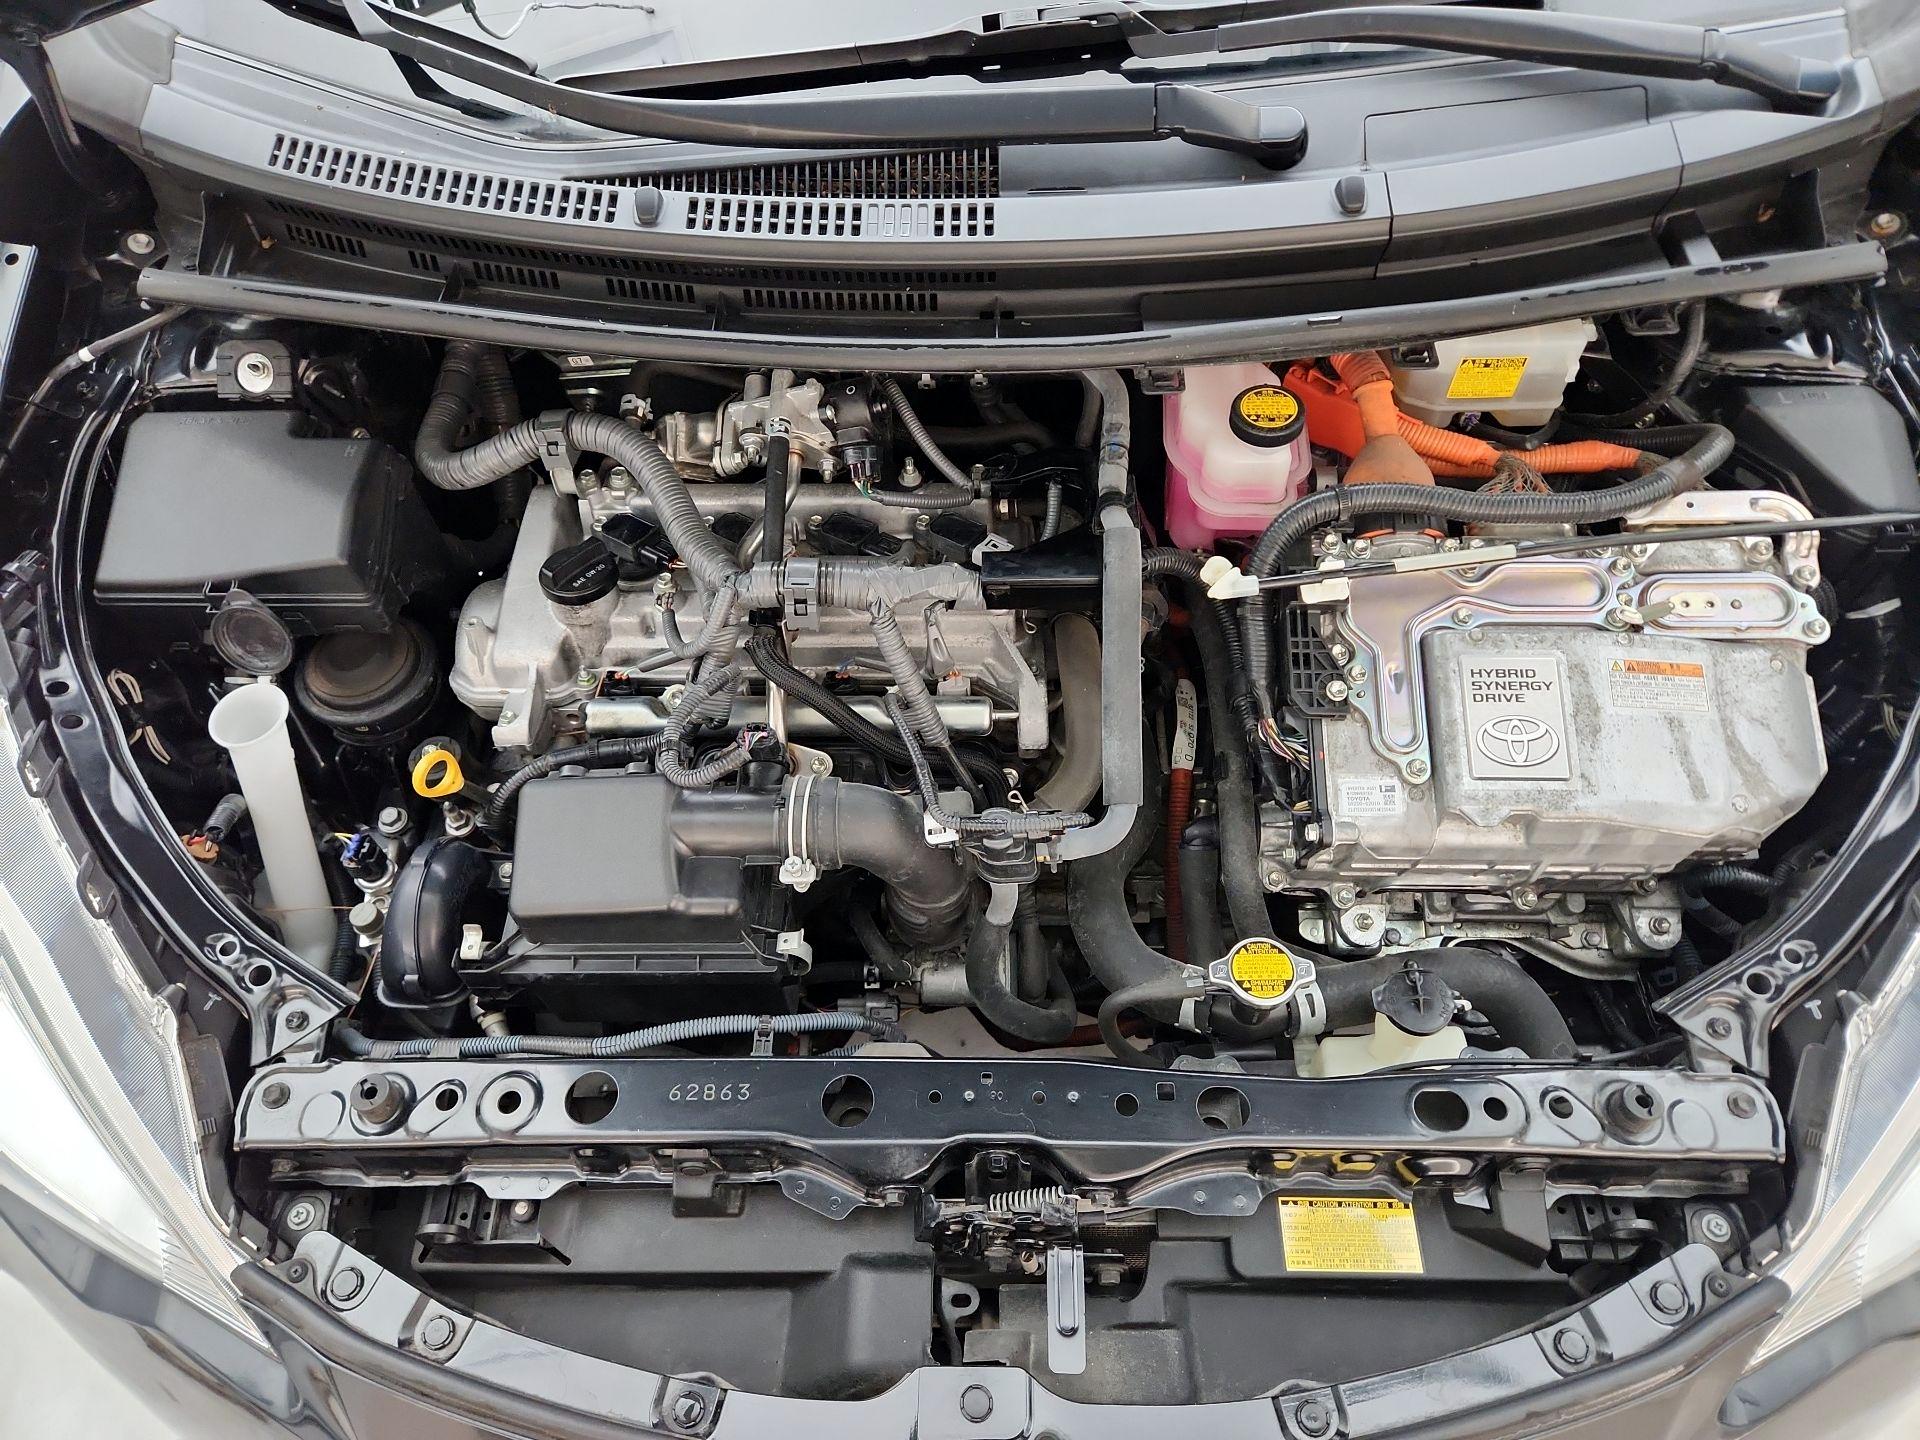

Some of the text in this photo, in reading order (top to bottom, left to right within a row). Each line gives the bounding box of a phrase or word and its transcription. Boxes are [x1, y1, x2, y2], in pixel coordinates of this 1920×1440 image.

[1470, 668, 1537, 678] HYBRID
[1471, 681, 1553, 691] SYNERGY
[1472, 693, 1526, 703] DRIVE
[669, 1083, 751, 1101] 62863
[1312, 1200, 1339, 1208] CAUTION
[1341, 1201, 1374, 1209] ATTENTION
